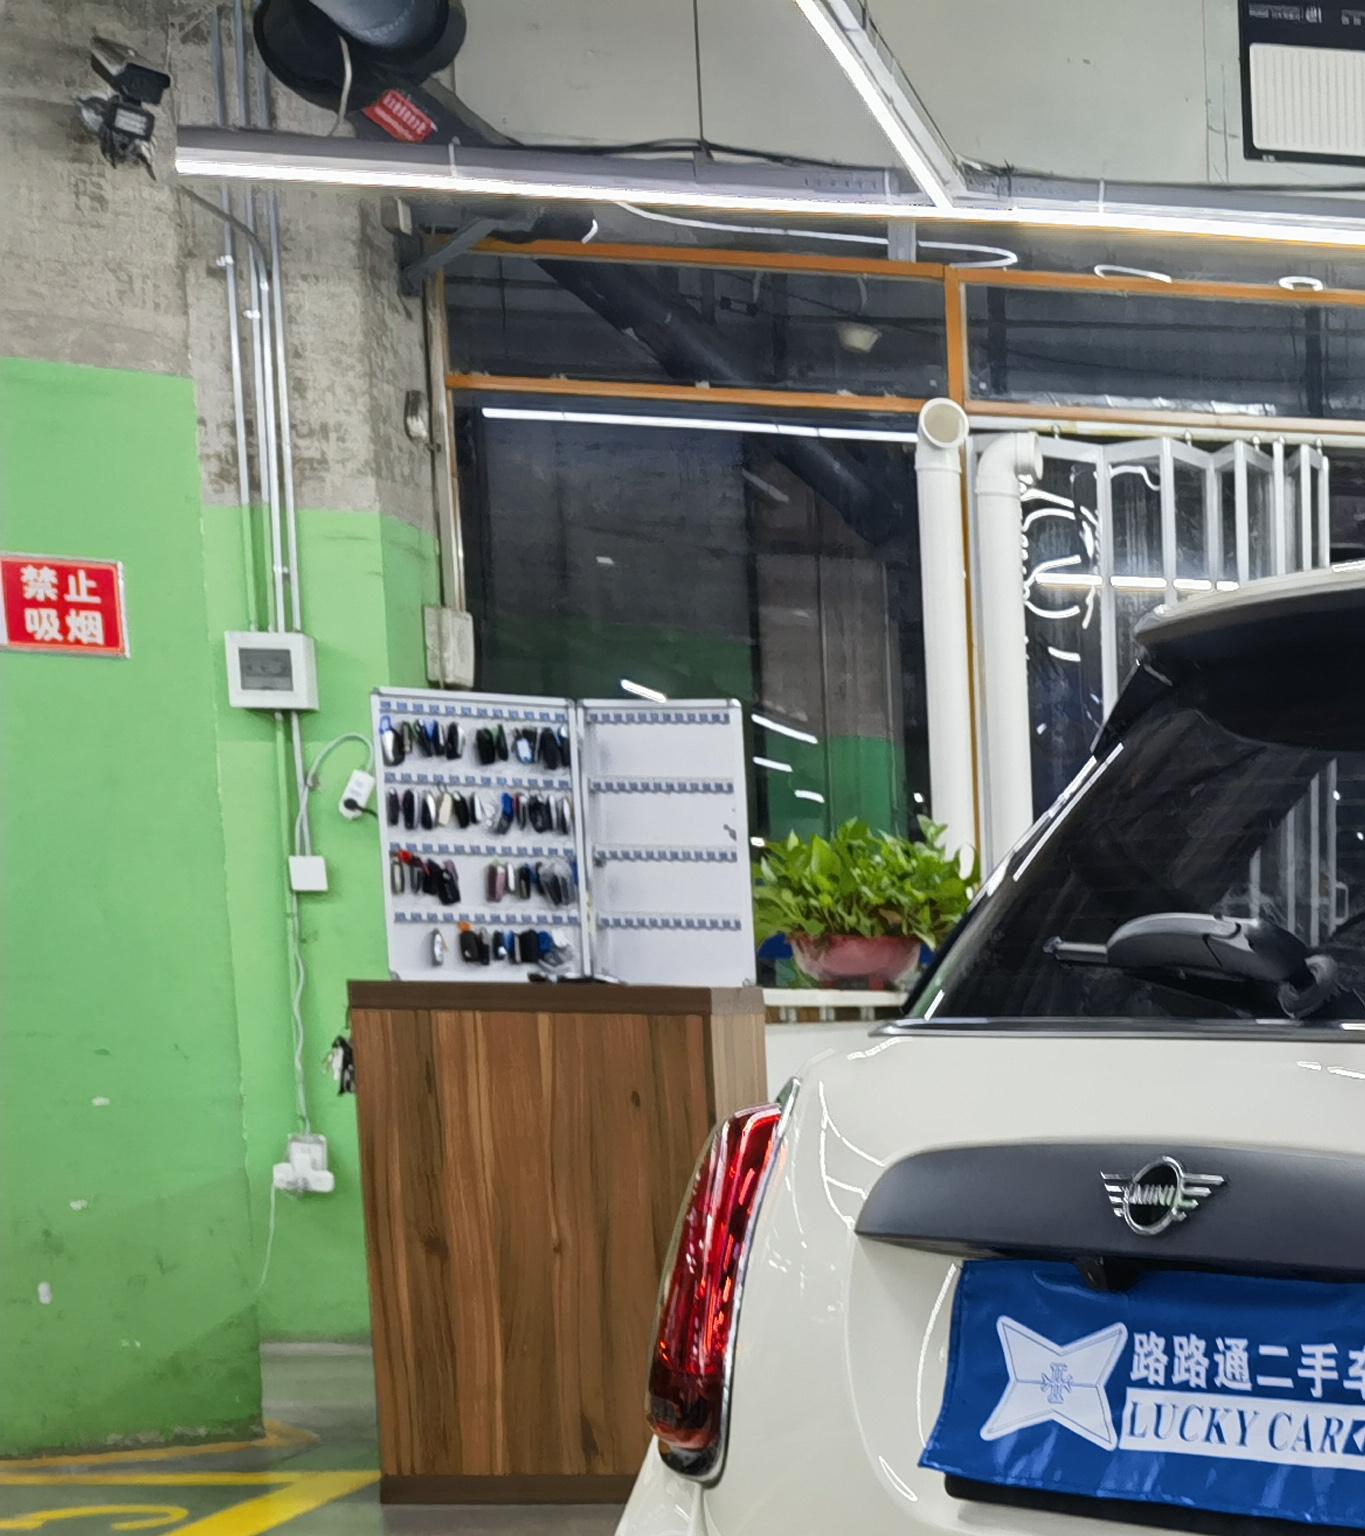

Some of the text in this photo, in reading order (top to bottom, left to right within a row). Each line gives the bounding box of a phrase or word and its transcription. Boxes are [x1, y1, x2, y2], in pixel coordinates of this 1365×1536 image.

[21, 565, 102, 604] 禁止
[24, 607, 105, 645] 吸烟
[1129, 1400, 1345, 1456] LUCKY CAR
